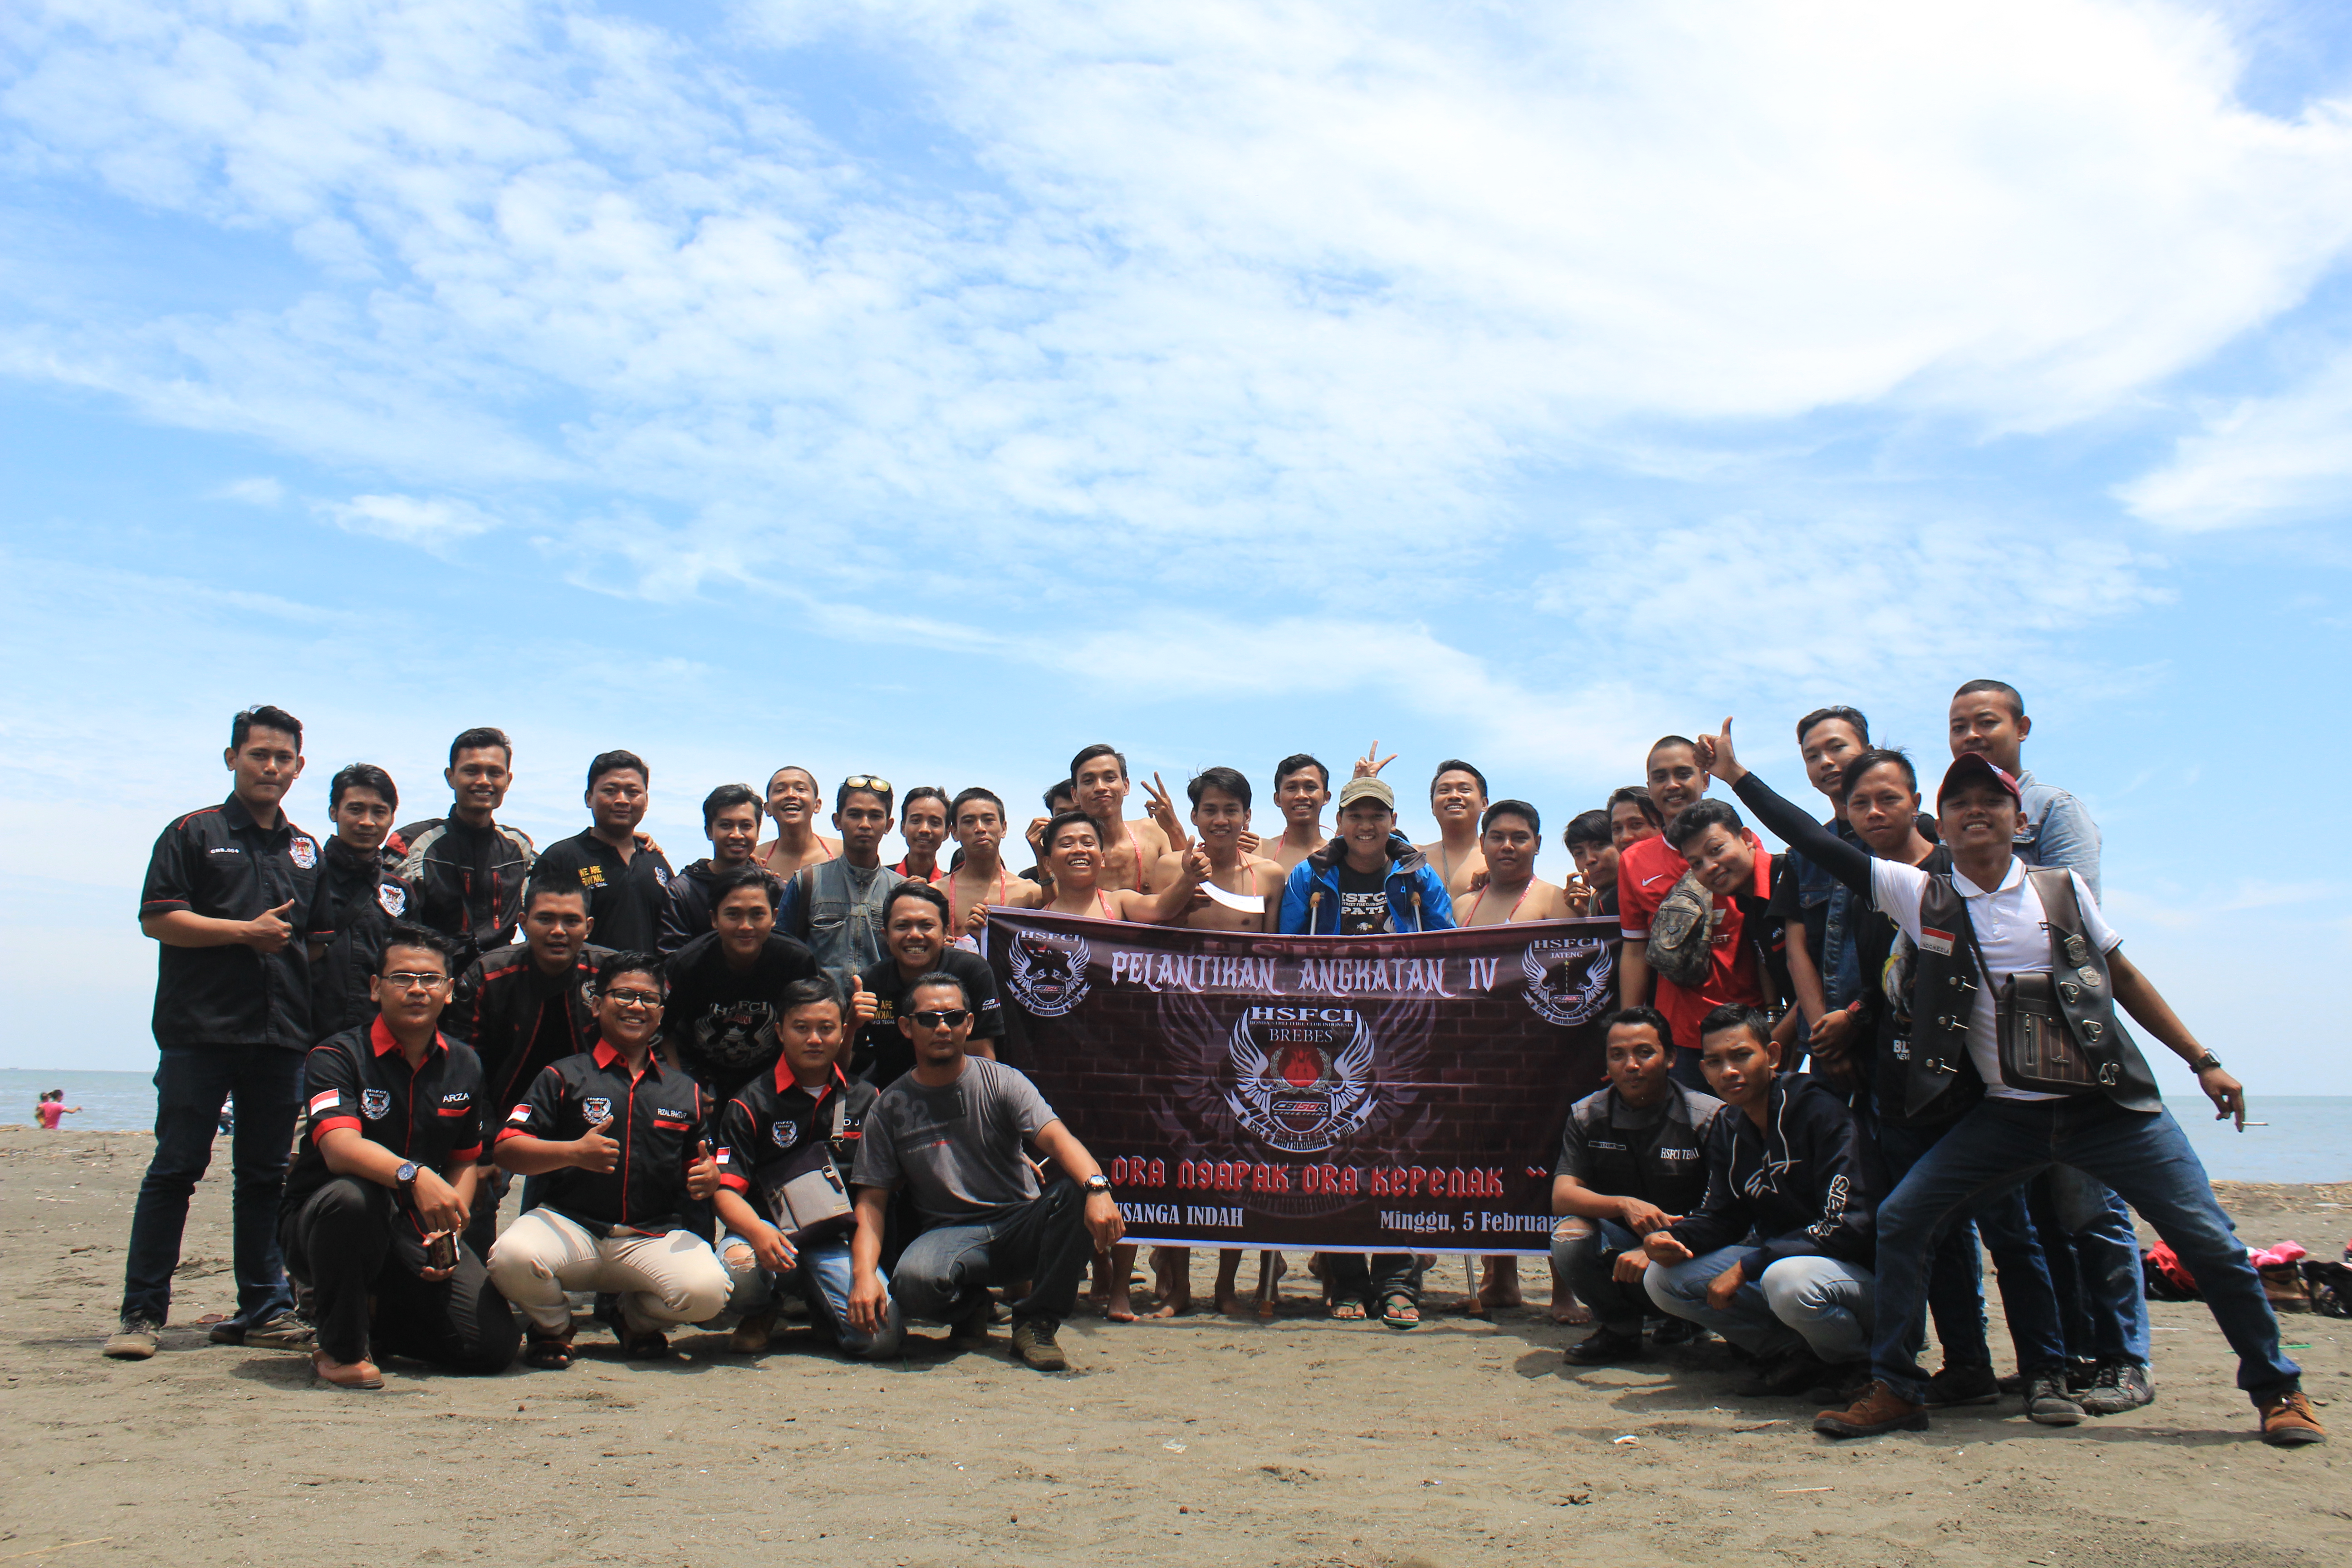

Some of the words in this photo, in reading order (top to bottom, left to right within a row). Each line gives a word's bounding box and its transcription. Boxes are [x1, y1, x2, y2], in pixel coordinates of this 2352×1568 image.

[1342, 892, 1387, 902] SFC
[1341, 906, 1384, 915] PATI
[1021, 931, 1079, 942] HSFCI
[1534, 938, 1599, 948] HSFCI
[1921, 942, 1950, 954] NDONESIA
[1111, 951, 1287, 996] PELANTIKAN
[1298, 958, 1456, 998] ANGKATAN
[1469, 958, 1499, 992] IV
[713, 1000, 768, 1016] HFCI
[1251, 1007, 1354, 1022] HSFCI
[1269, 1029, 1333, 1042] BREBES
[1894, 1039, 1911, 1053] BL
[442, 1093, 470, 1103] ARZA
[657, 1108, 671, 1117] RIZAL
[1272, 1101, 1328, 1112] CB150R
[1661, 1147, 1680, 1160] HSFCI
[1111, 1155, 1166, 1188] ORA
[1302, 1163, 1358, 1196] ORA
[1187, 1205, 1243, 1227] INDAH
[1380, 1210, 1455, 1233] Minggu,
[1463, 1212, 1474, 1231] 5
[1481, 1212, 1563, 1233] Februar
